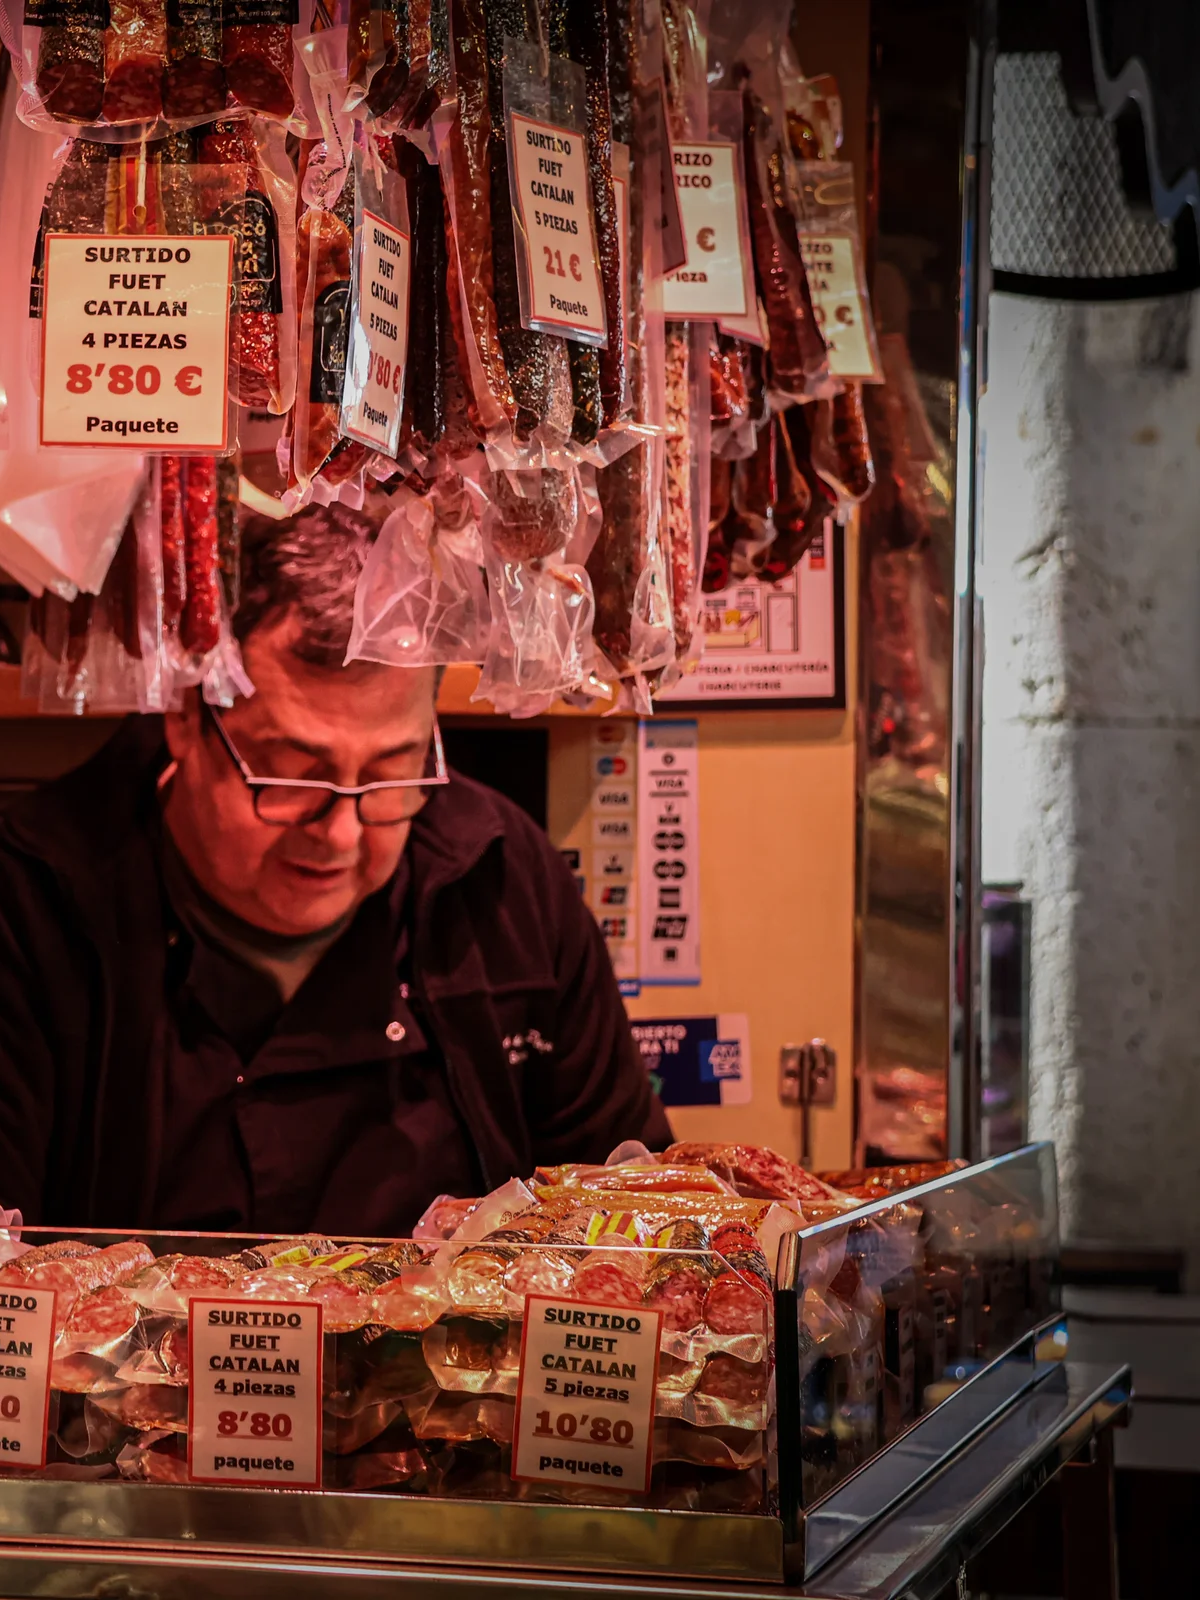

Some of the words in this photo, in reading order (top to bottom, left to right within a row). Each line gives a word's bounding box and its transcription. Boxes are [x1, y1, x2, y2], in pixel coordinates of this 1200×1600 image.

[526, 129, 572, 155] SURTIDO
[538, 157, 563, 178] FUET
[674, 154, 713, 166] RIZO
[531, 179, 574, 205] CATALAN
[676, 176, 712, 188] RICO
[535, 210, 542, 225] 5
[544, 212, 578, 235] PIEZAS
[373, 228, 401, 258] SURTIDO
[696, 227, 716, 252] €
[85, 247, 191, 263] SURTIDO
[545, 247, 566, 277] 21
[569, 254, 582, 282] €
[378, 258, 394, 281] FUET
[667, 271, 708, 282] ieza
[108, 274, 166, 290] FUET
[371, 281, 399, 310] CATALAN
[550, 294, 589, 316] Paquete
[84, 300, 187, 317] CATALAN
[370, 313, 376, 328] 5
[377, 315, 398, 342] PIEZAS
[82, 334, 96, 348] 4
[103, 333, 187, 349] PIEZAS
[66, 364, 161, 395] 8'80
[174, 364, 202, 396] €
[367, 350, 391, 389] 0'80
[86, 416, 178, 435] Paquete
[363, 402, 388, 427] Paquete
[208, 1310, 302, 1328] SURTIDO
[544, 1307, 642, 1333] SURTIDO
[230, 1333, 280, 1350] FUET
[565, 1333, 618, 1353] FUET
[209, 1356, 300, 1374] CATALAN
[541, 1353, 637, 1379] CATALAN
[213, 1378, 228, 1394] 4
[232, 1379, 295, 1398] piezas
[545, 1378, 557, 1393] 5
[562, 1379, 630, 1402] piezas
[217, 1411, 292, 1438] 8'80
[533, 1411, 634, 1444] 10'80
[214, 1454, 295, 1473] paquete
[539, 1455, 624, 1478] paquete
